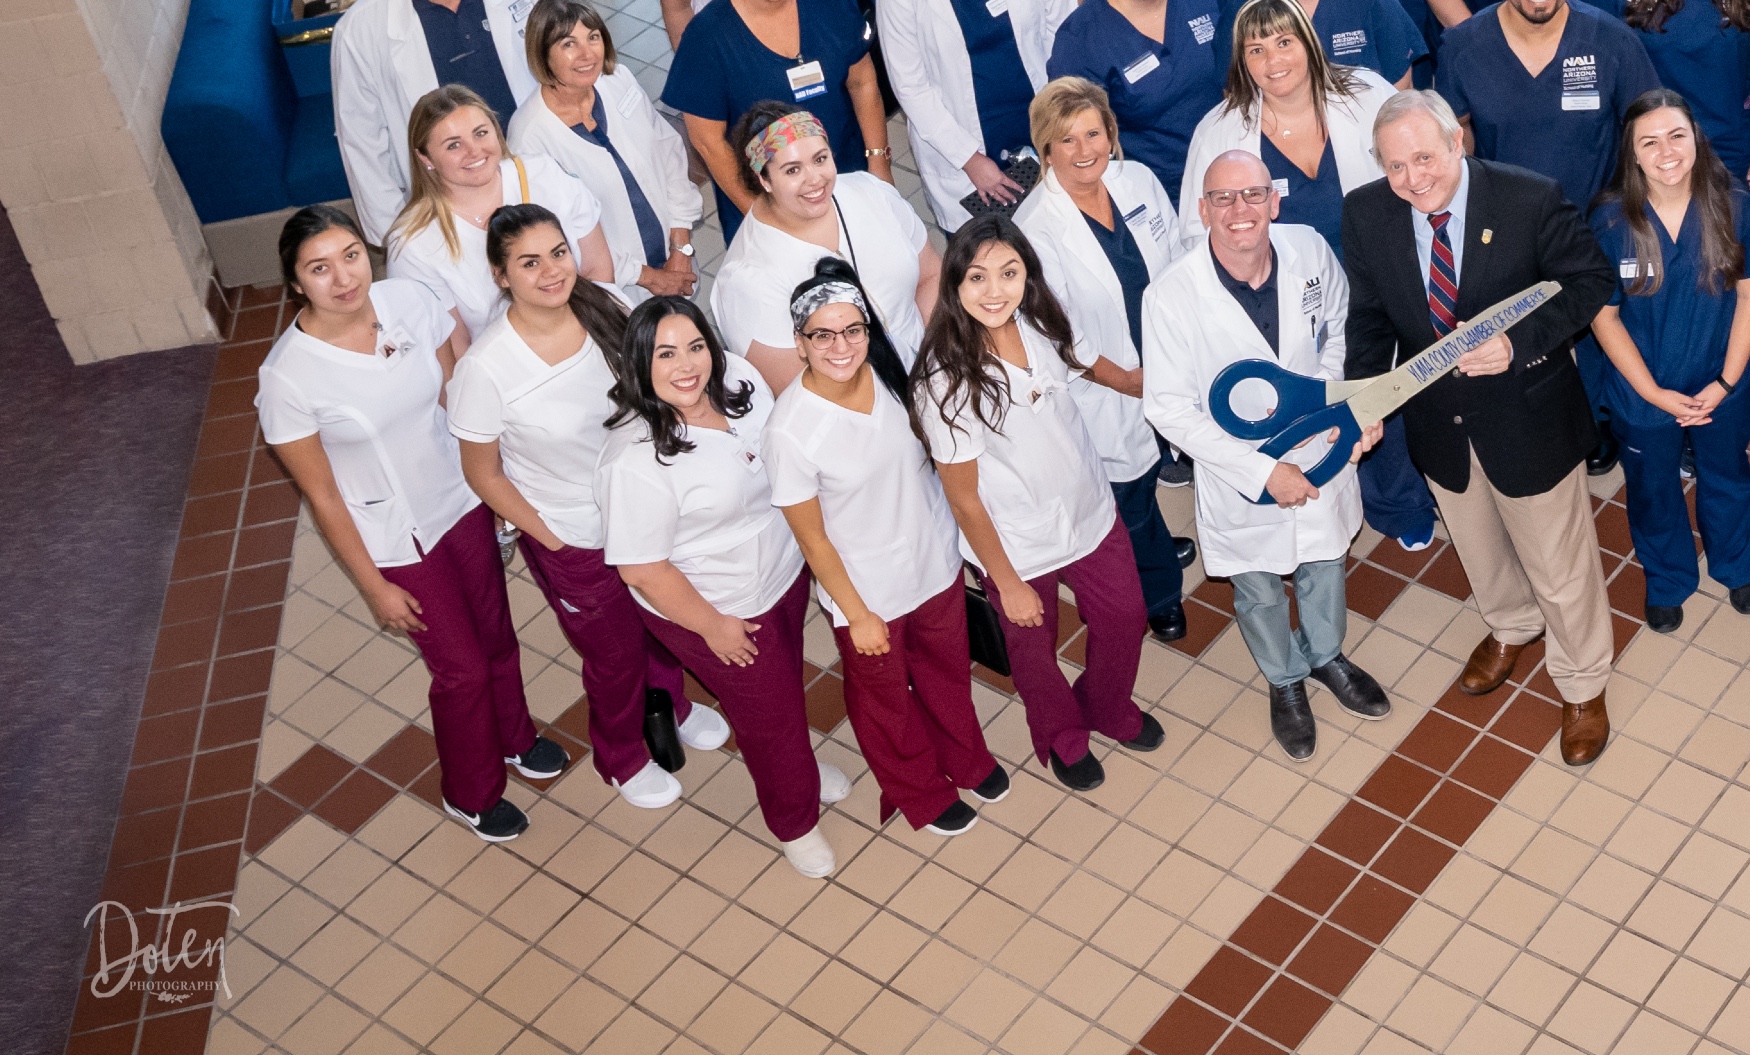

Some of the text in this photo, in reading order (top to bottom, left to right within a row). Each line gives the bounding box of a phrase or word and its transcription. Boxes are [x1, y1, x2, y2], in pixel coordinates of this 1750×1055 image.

[1188, 13, 1211, 28] NAU
[1563, 55, 1595, 67] NAU
[1304, 276, 1320, 291] AU
[1406, 288, 1547, 384] YUMA COUNTY CHAMBER OF COMMERCE
